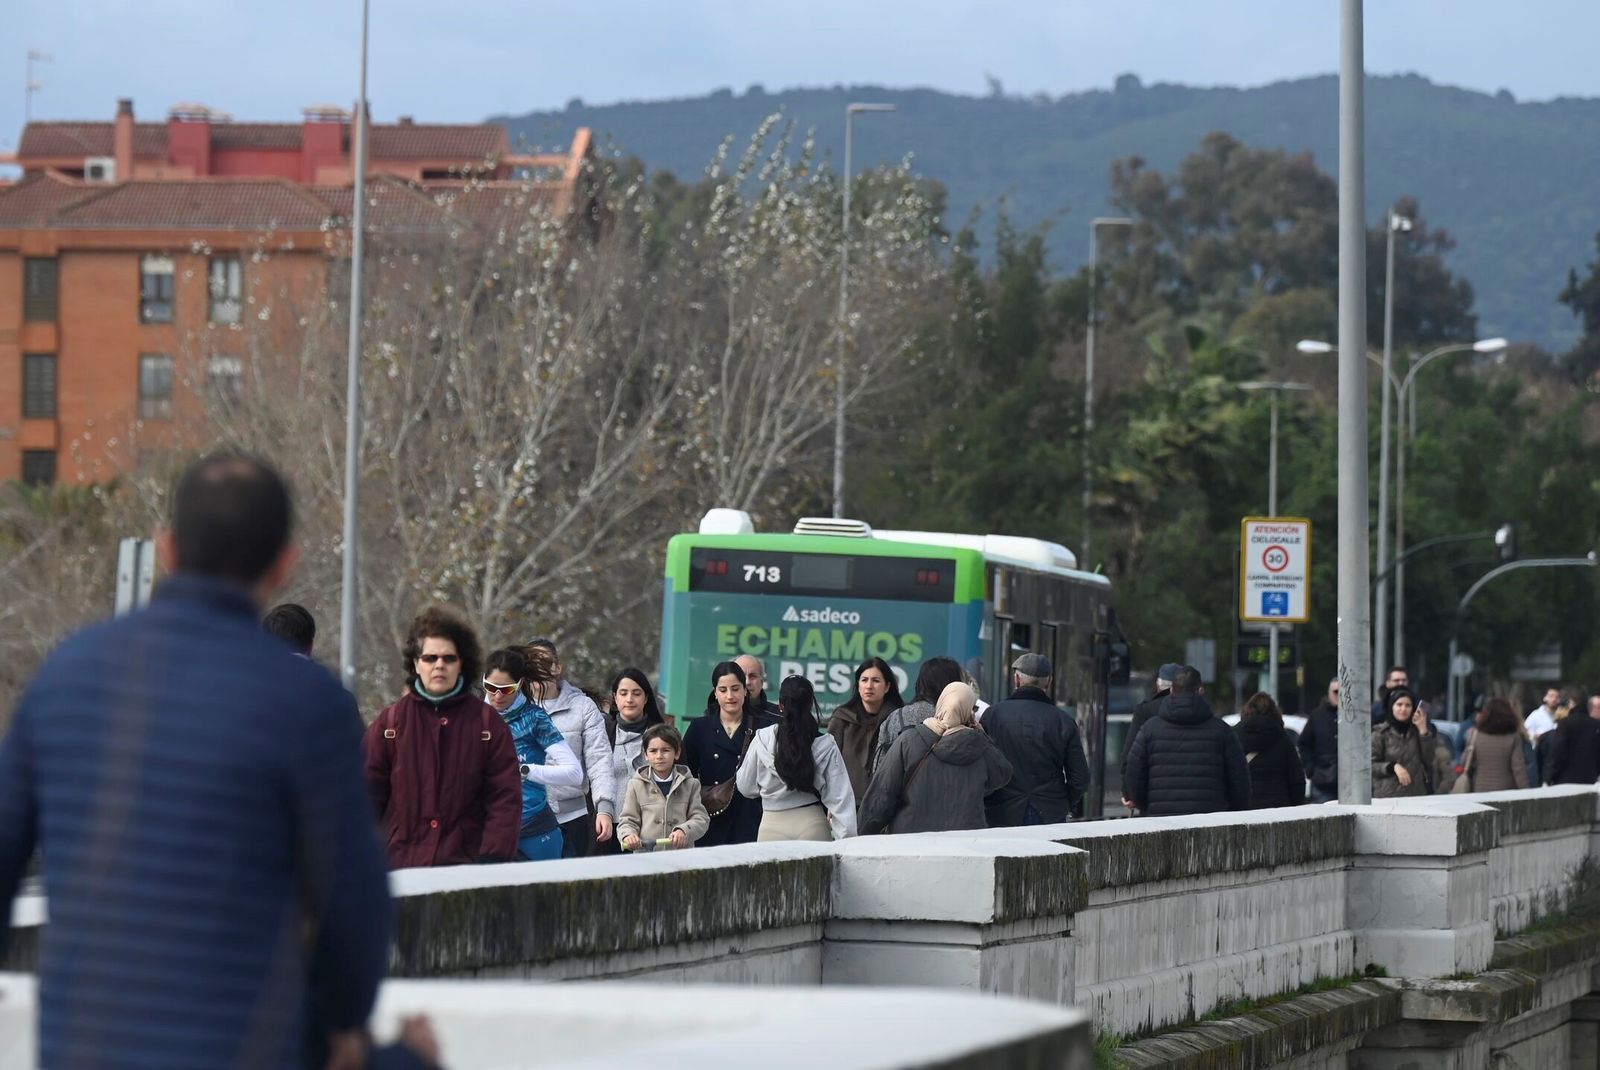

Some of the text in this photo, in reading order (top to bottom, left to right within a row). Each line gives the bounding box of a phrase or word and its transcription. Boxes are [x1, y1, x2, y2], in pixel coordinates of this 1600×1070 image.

[1254, 525, 1299, 534] ATENCIÓN
[1251, 536, 1301, 544] CICLOCALLE
[1268, 554, 1283, 564] 30
[742, 564, 782, 583] 713
[800, 607, 860, 624] sadeco
[717, 624, 923, 663] ECHAMOS
[780, 661, 908, 695] RESO
